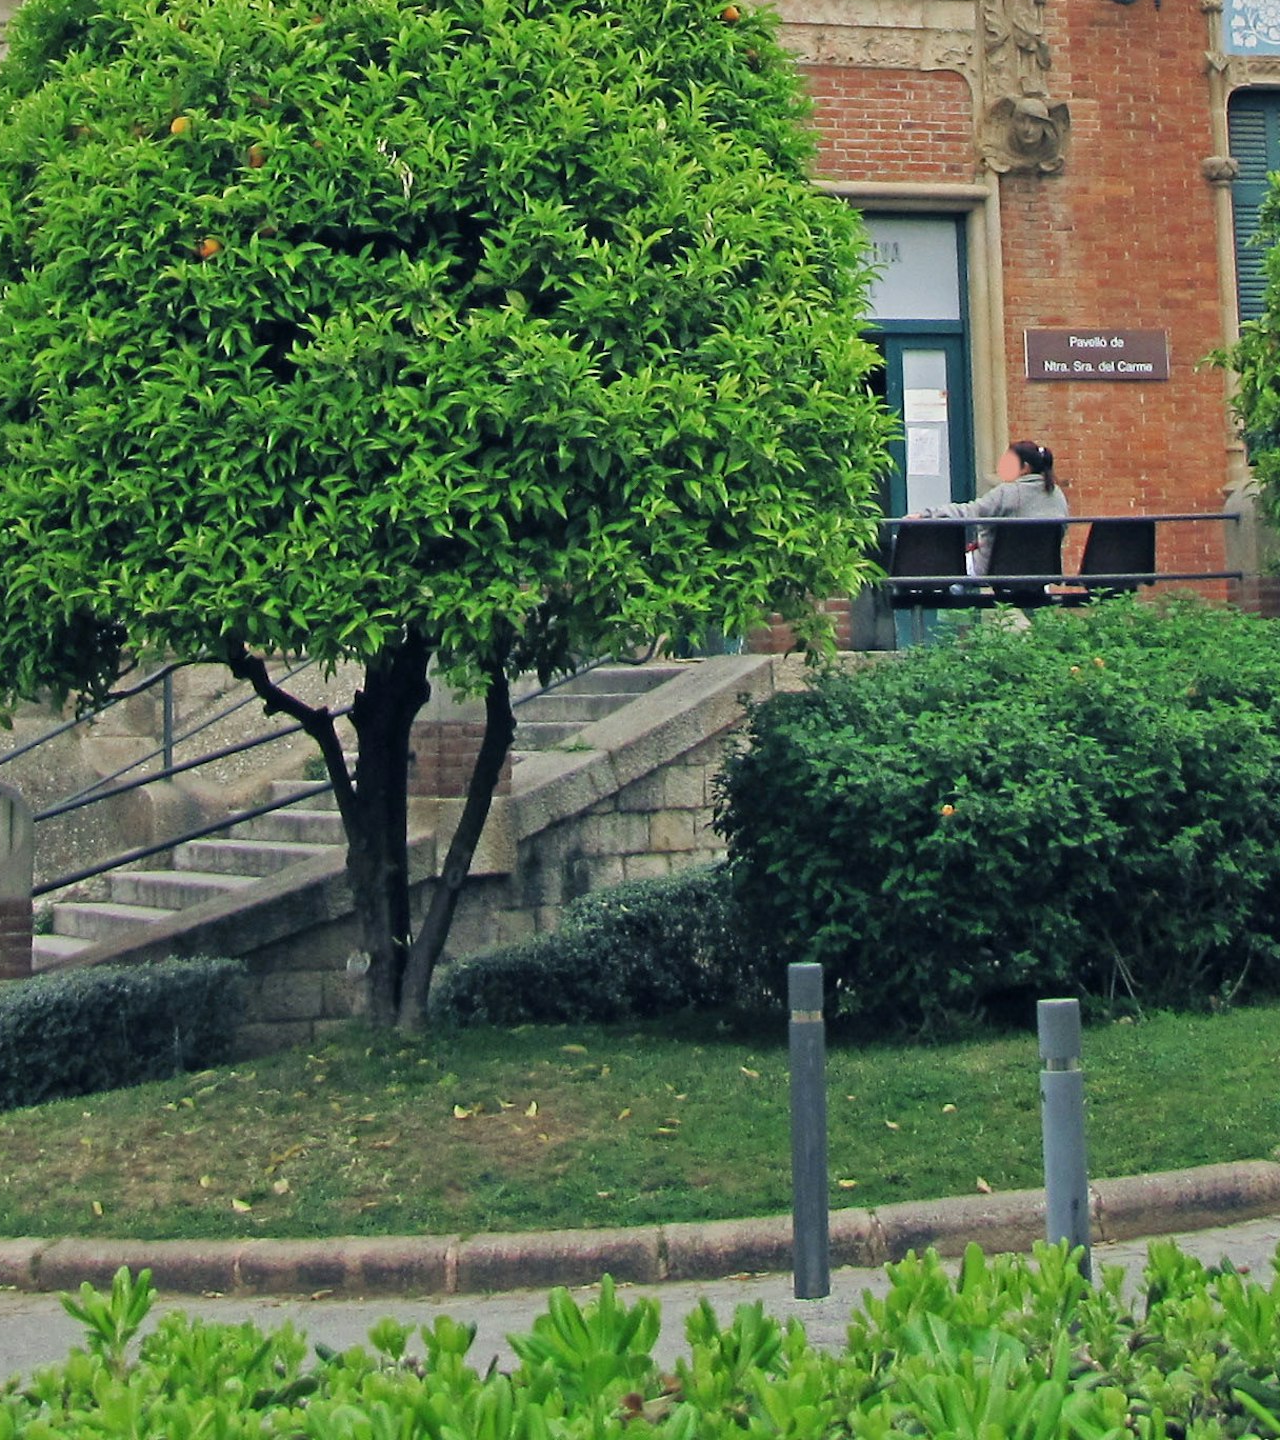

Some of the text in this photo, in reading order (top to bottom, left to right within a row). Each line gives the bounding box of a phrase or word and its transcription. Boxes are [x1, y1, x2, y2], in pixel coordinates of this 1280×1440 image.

[1110, 335, 1125, 348] de
[1044, 360, 1153, 373] Ntra. Sra. del Carme
